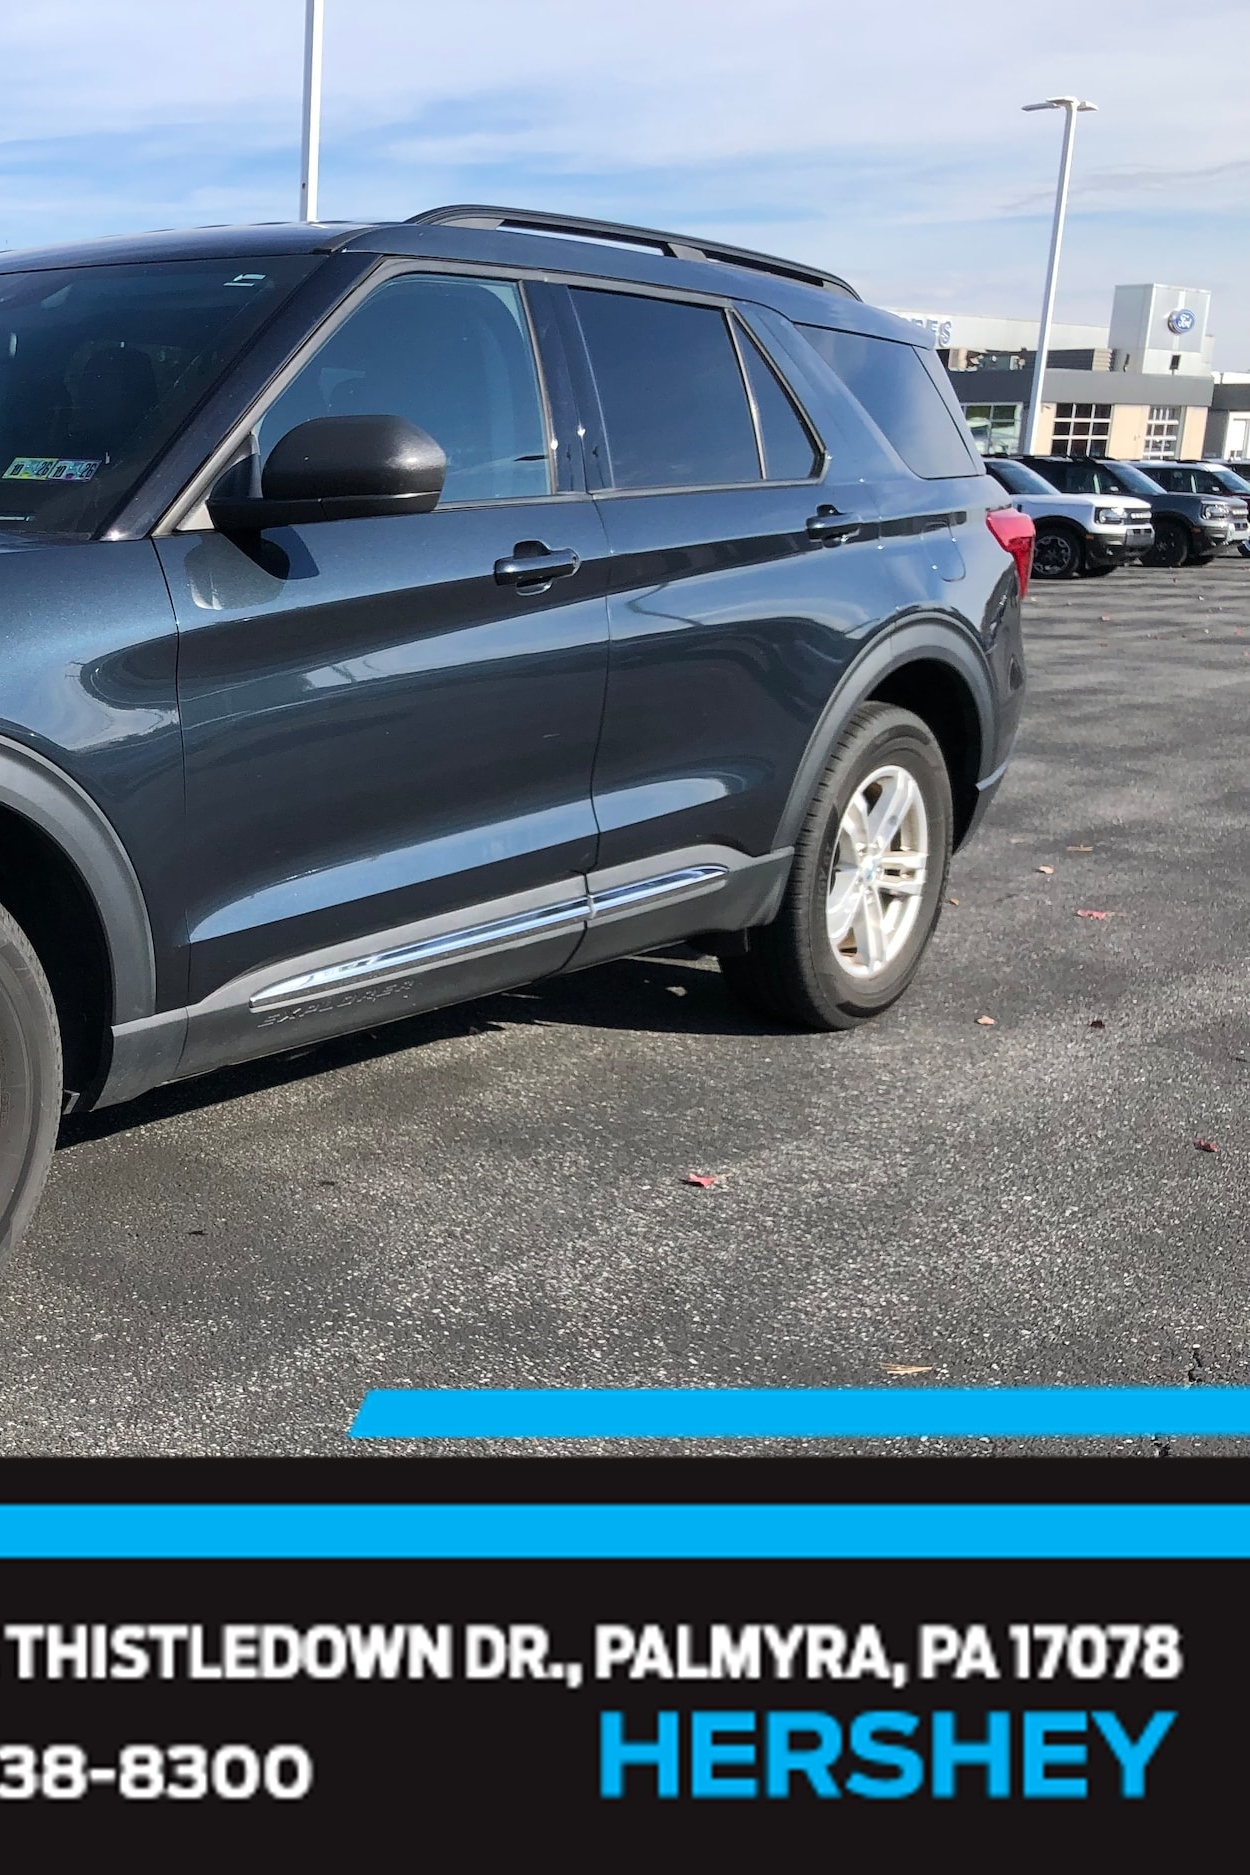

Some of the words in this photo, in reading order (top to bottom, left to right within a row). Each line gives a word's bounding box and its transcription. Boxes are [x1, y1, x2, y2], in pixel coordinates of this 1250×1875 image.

[10, 463, 25, 476] 10
[37, 461, 53, 476] 26
[52, 465, 68, 478] 10
[80, 463, 96, 478] 26
[257, 980, 415, 1028] EXPLORER
